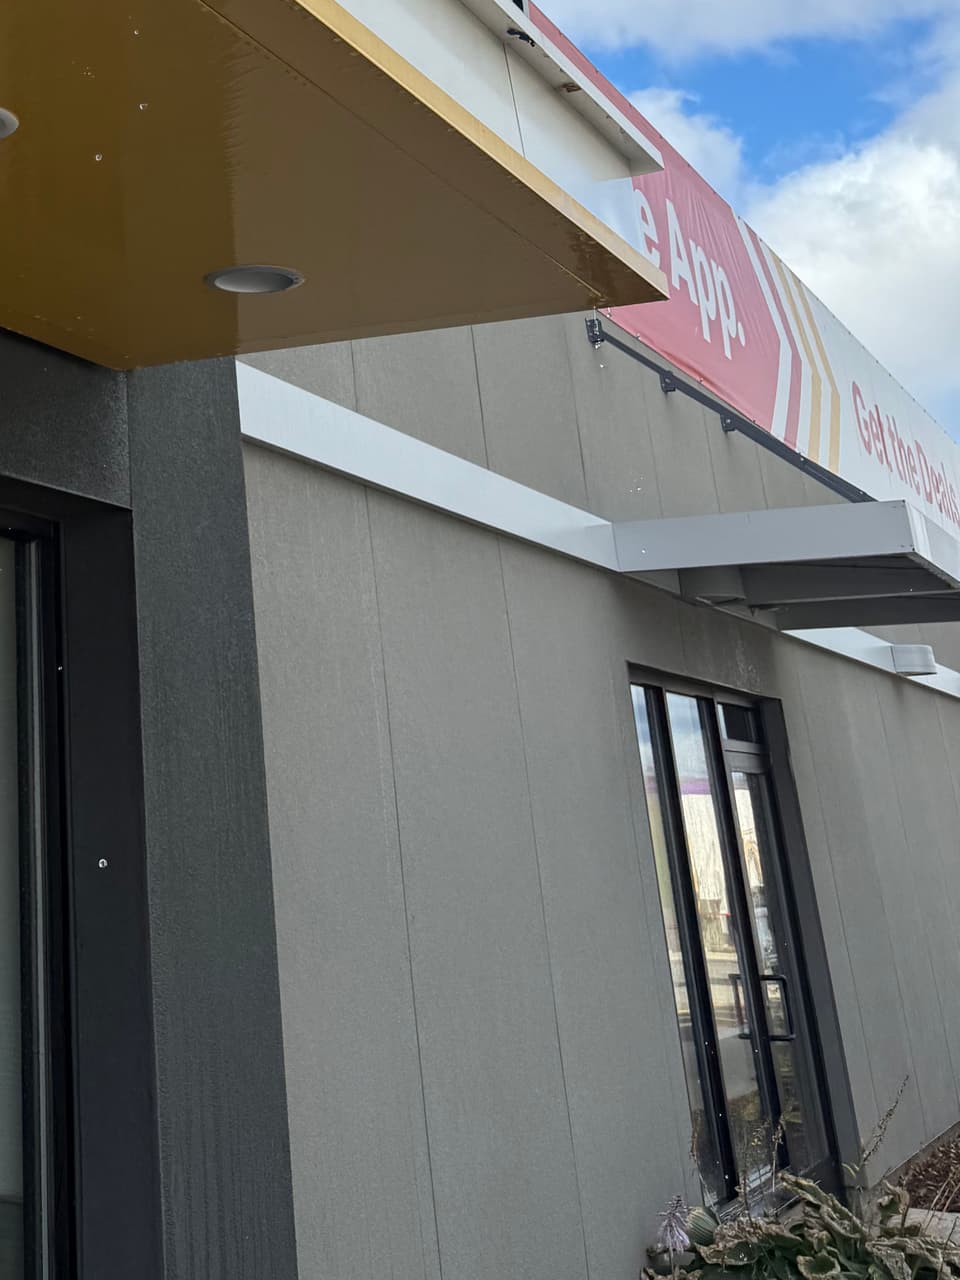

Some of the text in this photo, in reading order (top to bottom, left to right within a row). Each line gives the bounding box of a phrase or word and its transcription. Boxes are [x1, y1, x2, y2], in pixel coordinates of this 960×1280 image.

[665, 198, 746, 360] App.
[852, 380, 893, 473] Get
[886, 414, 921, 496] the
